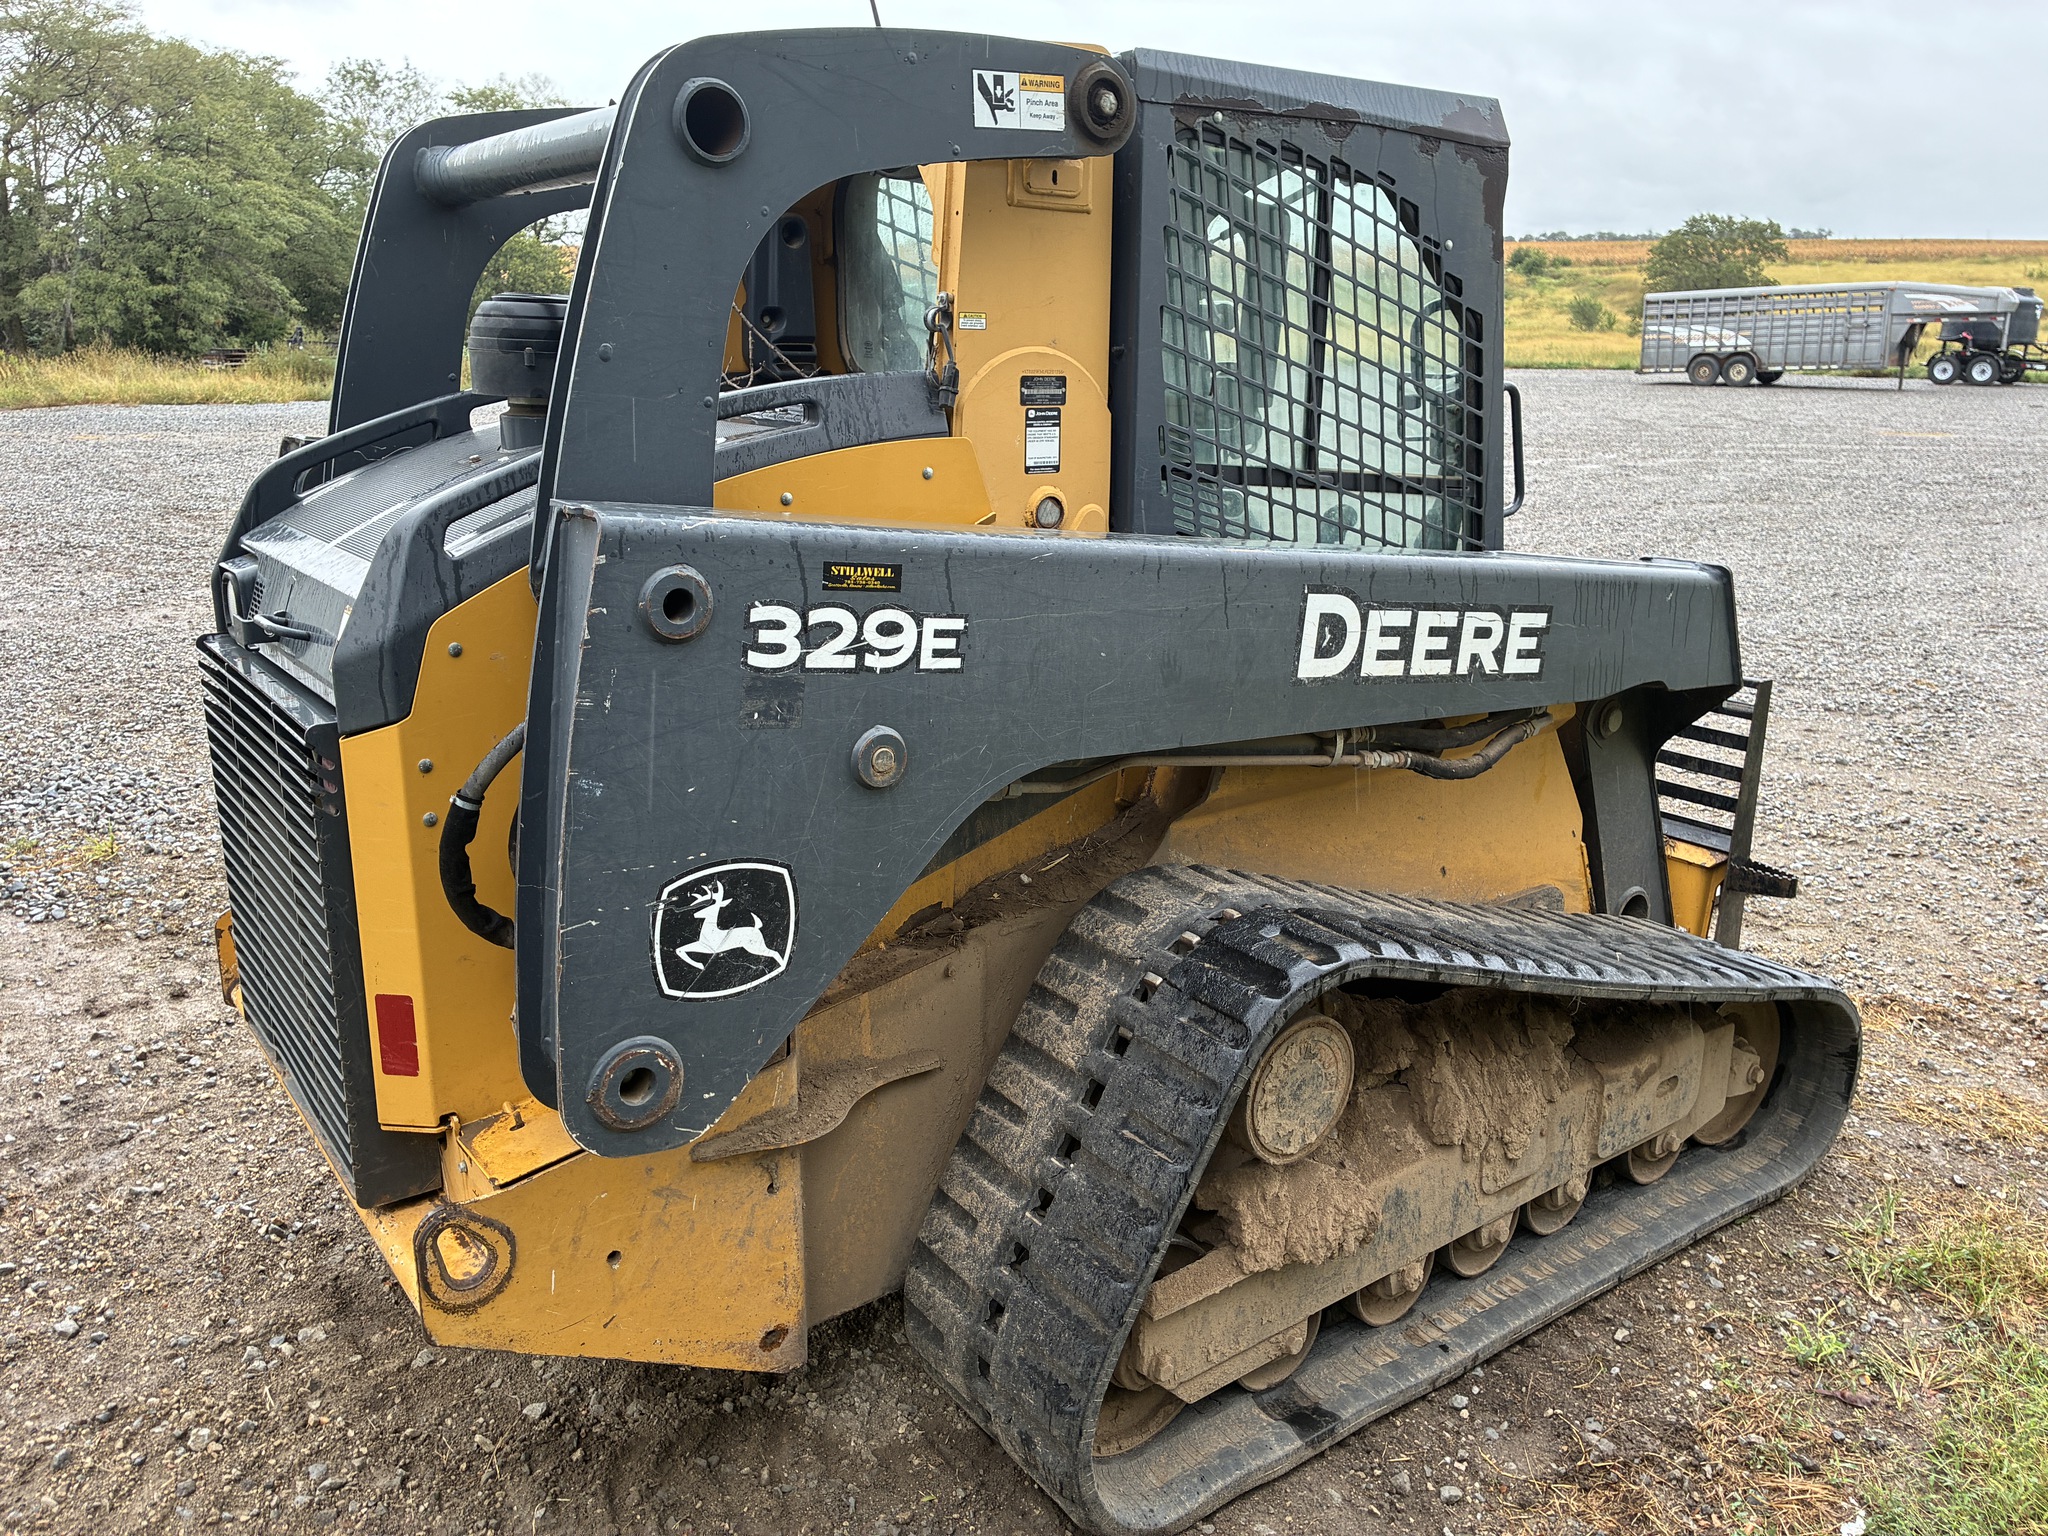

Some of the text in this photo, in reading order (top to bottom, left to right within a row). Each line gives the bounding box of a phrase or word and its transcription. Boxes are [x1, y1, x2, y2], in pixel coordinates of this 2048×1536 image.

[1028, 79, 1060, 89] WARNING
[1026, 98, 1058, 107] Pinch Area
[830, 565, 895, 578] STILLWELL
[747, 604, 966, 670] 329E
[1296, 592, 1549, 678] DEERE
